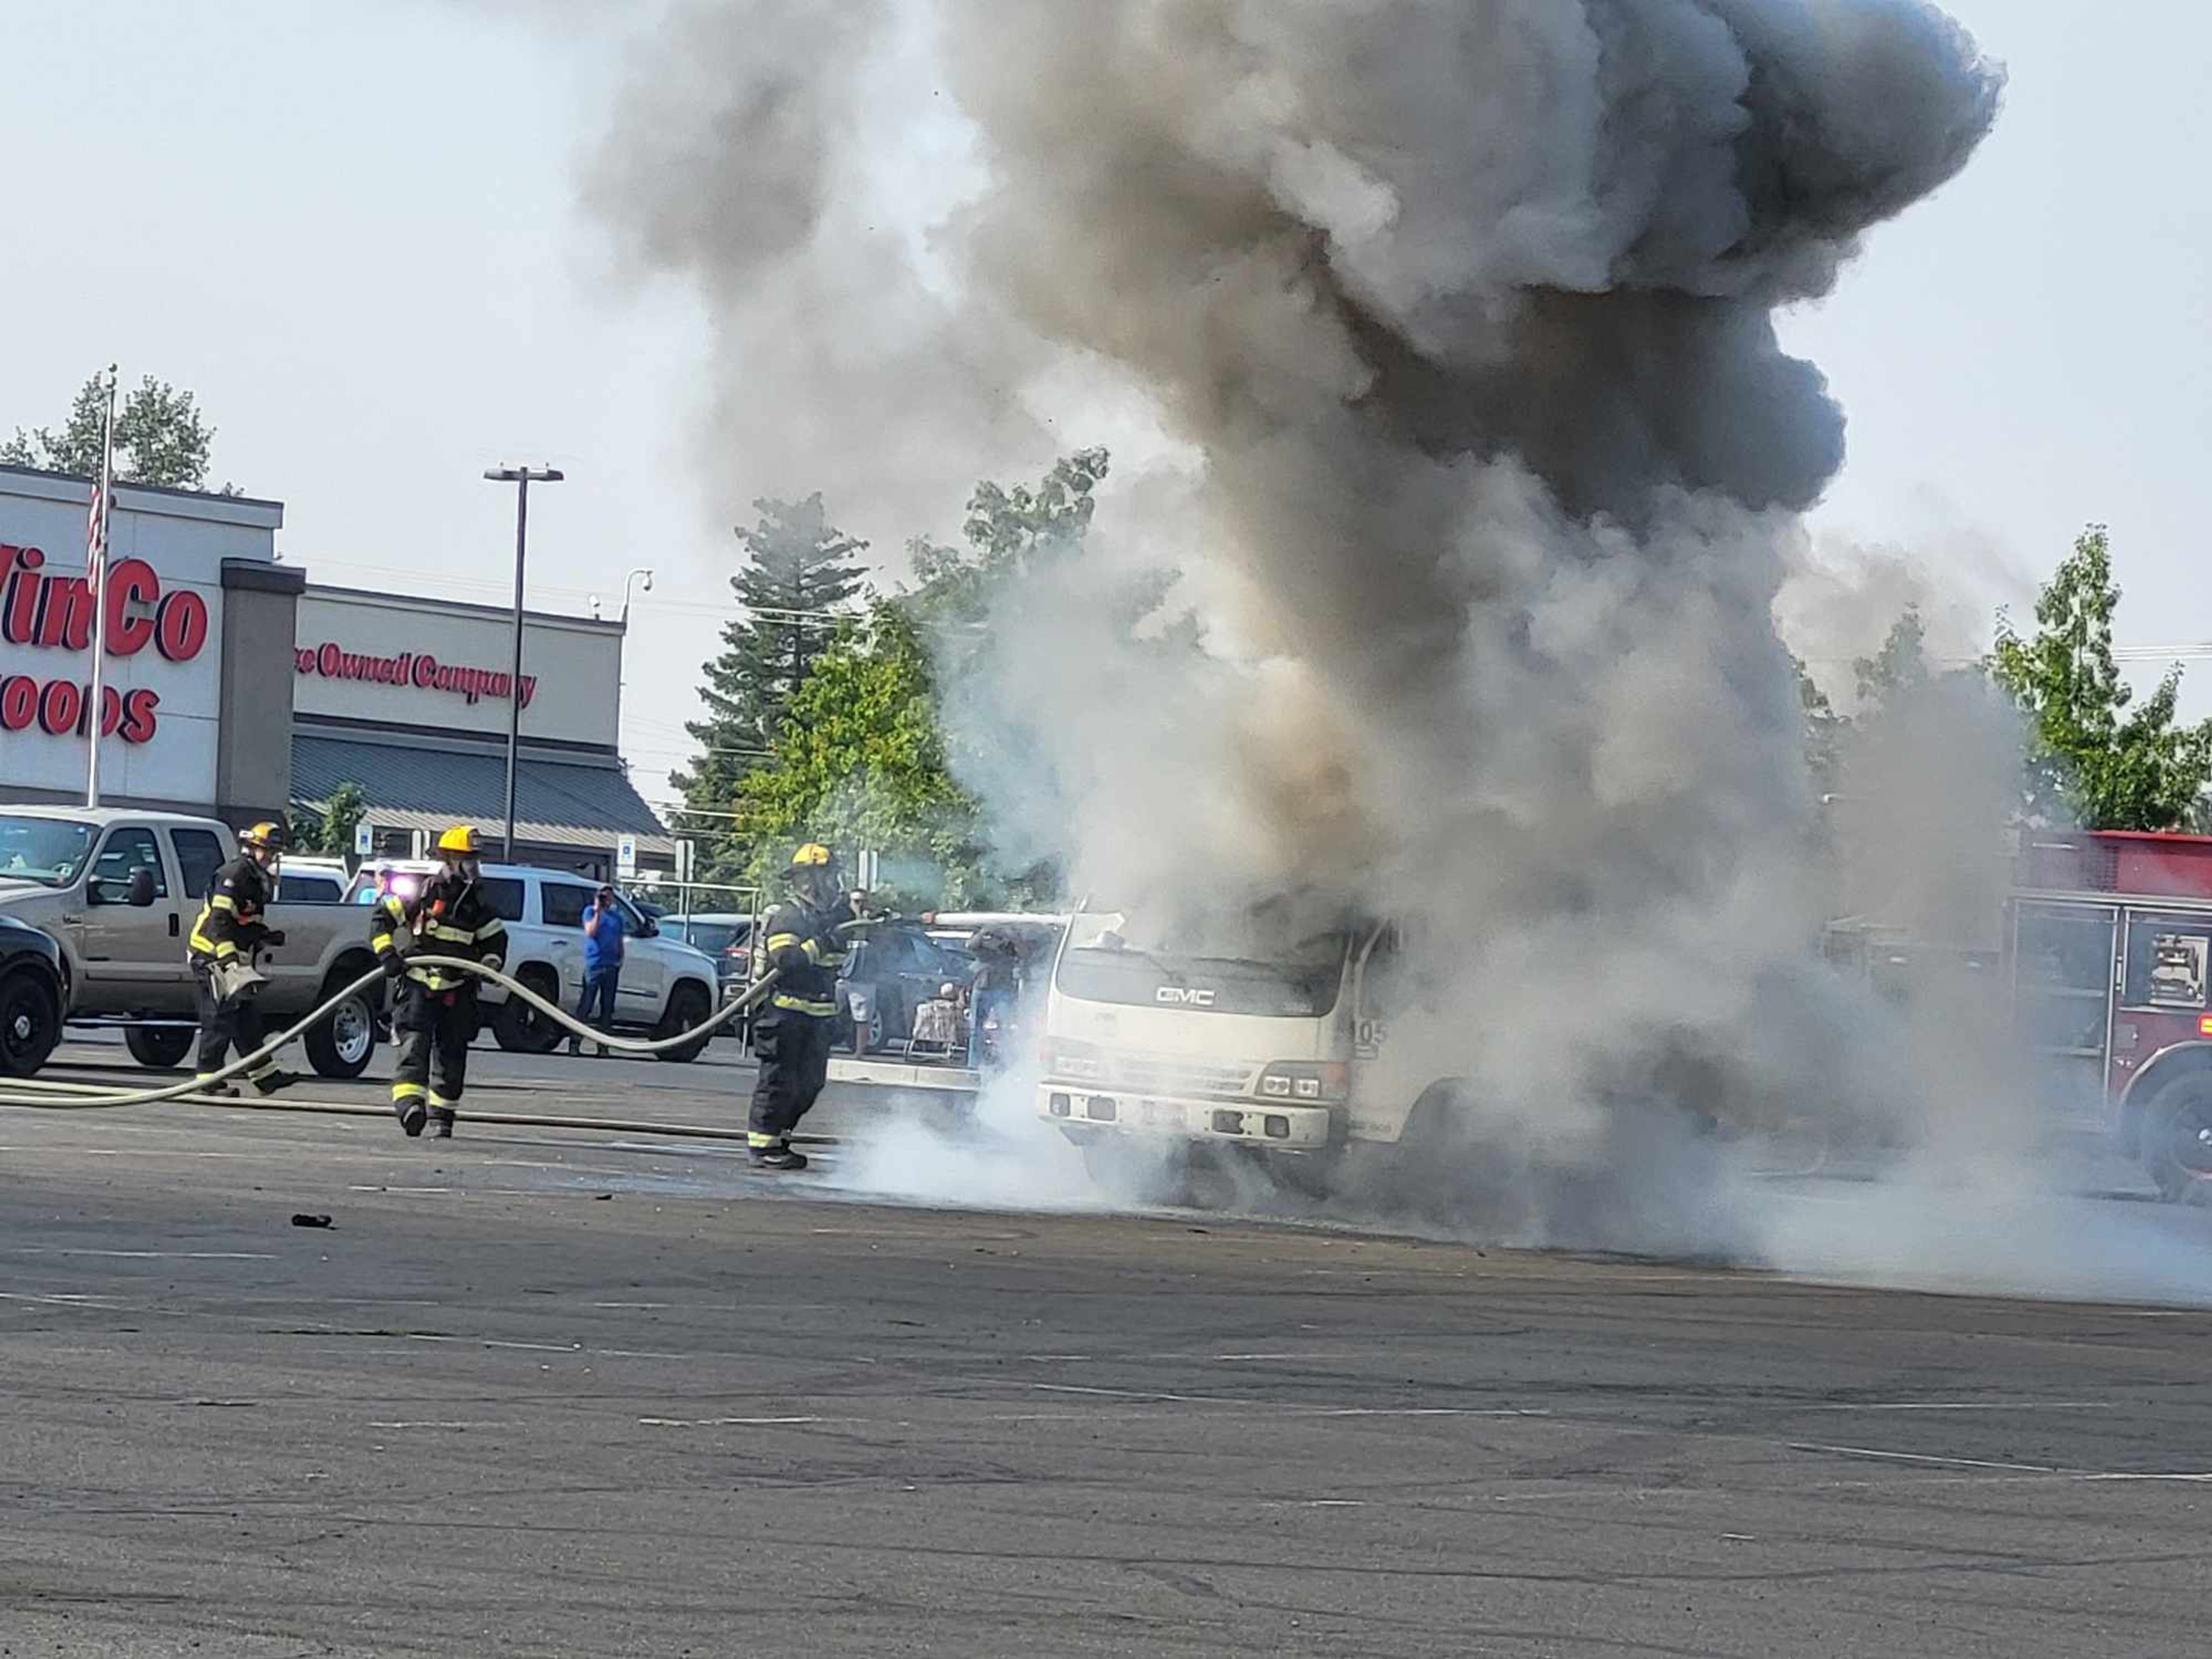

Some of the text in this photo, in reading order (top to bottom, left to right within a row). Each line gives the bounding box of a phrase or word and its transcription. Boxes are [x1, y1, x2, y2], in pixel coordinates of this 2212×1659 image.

[316, 642, 412, 686] Owned
[0, 675, 160, 743] OODS
[1155, 986, 1215, 1006] GMC
